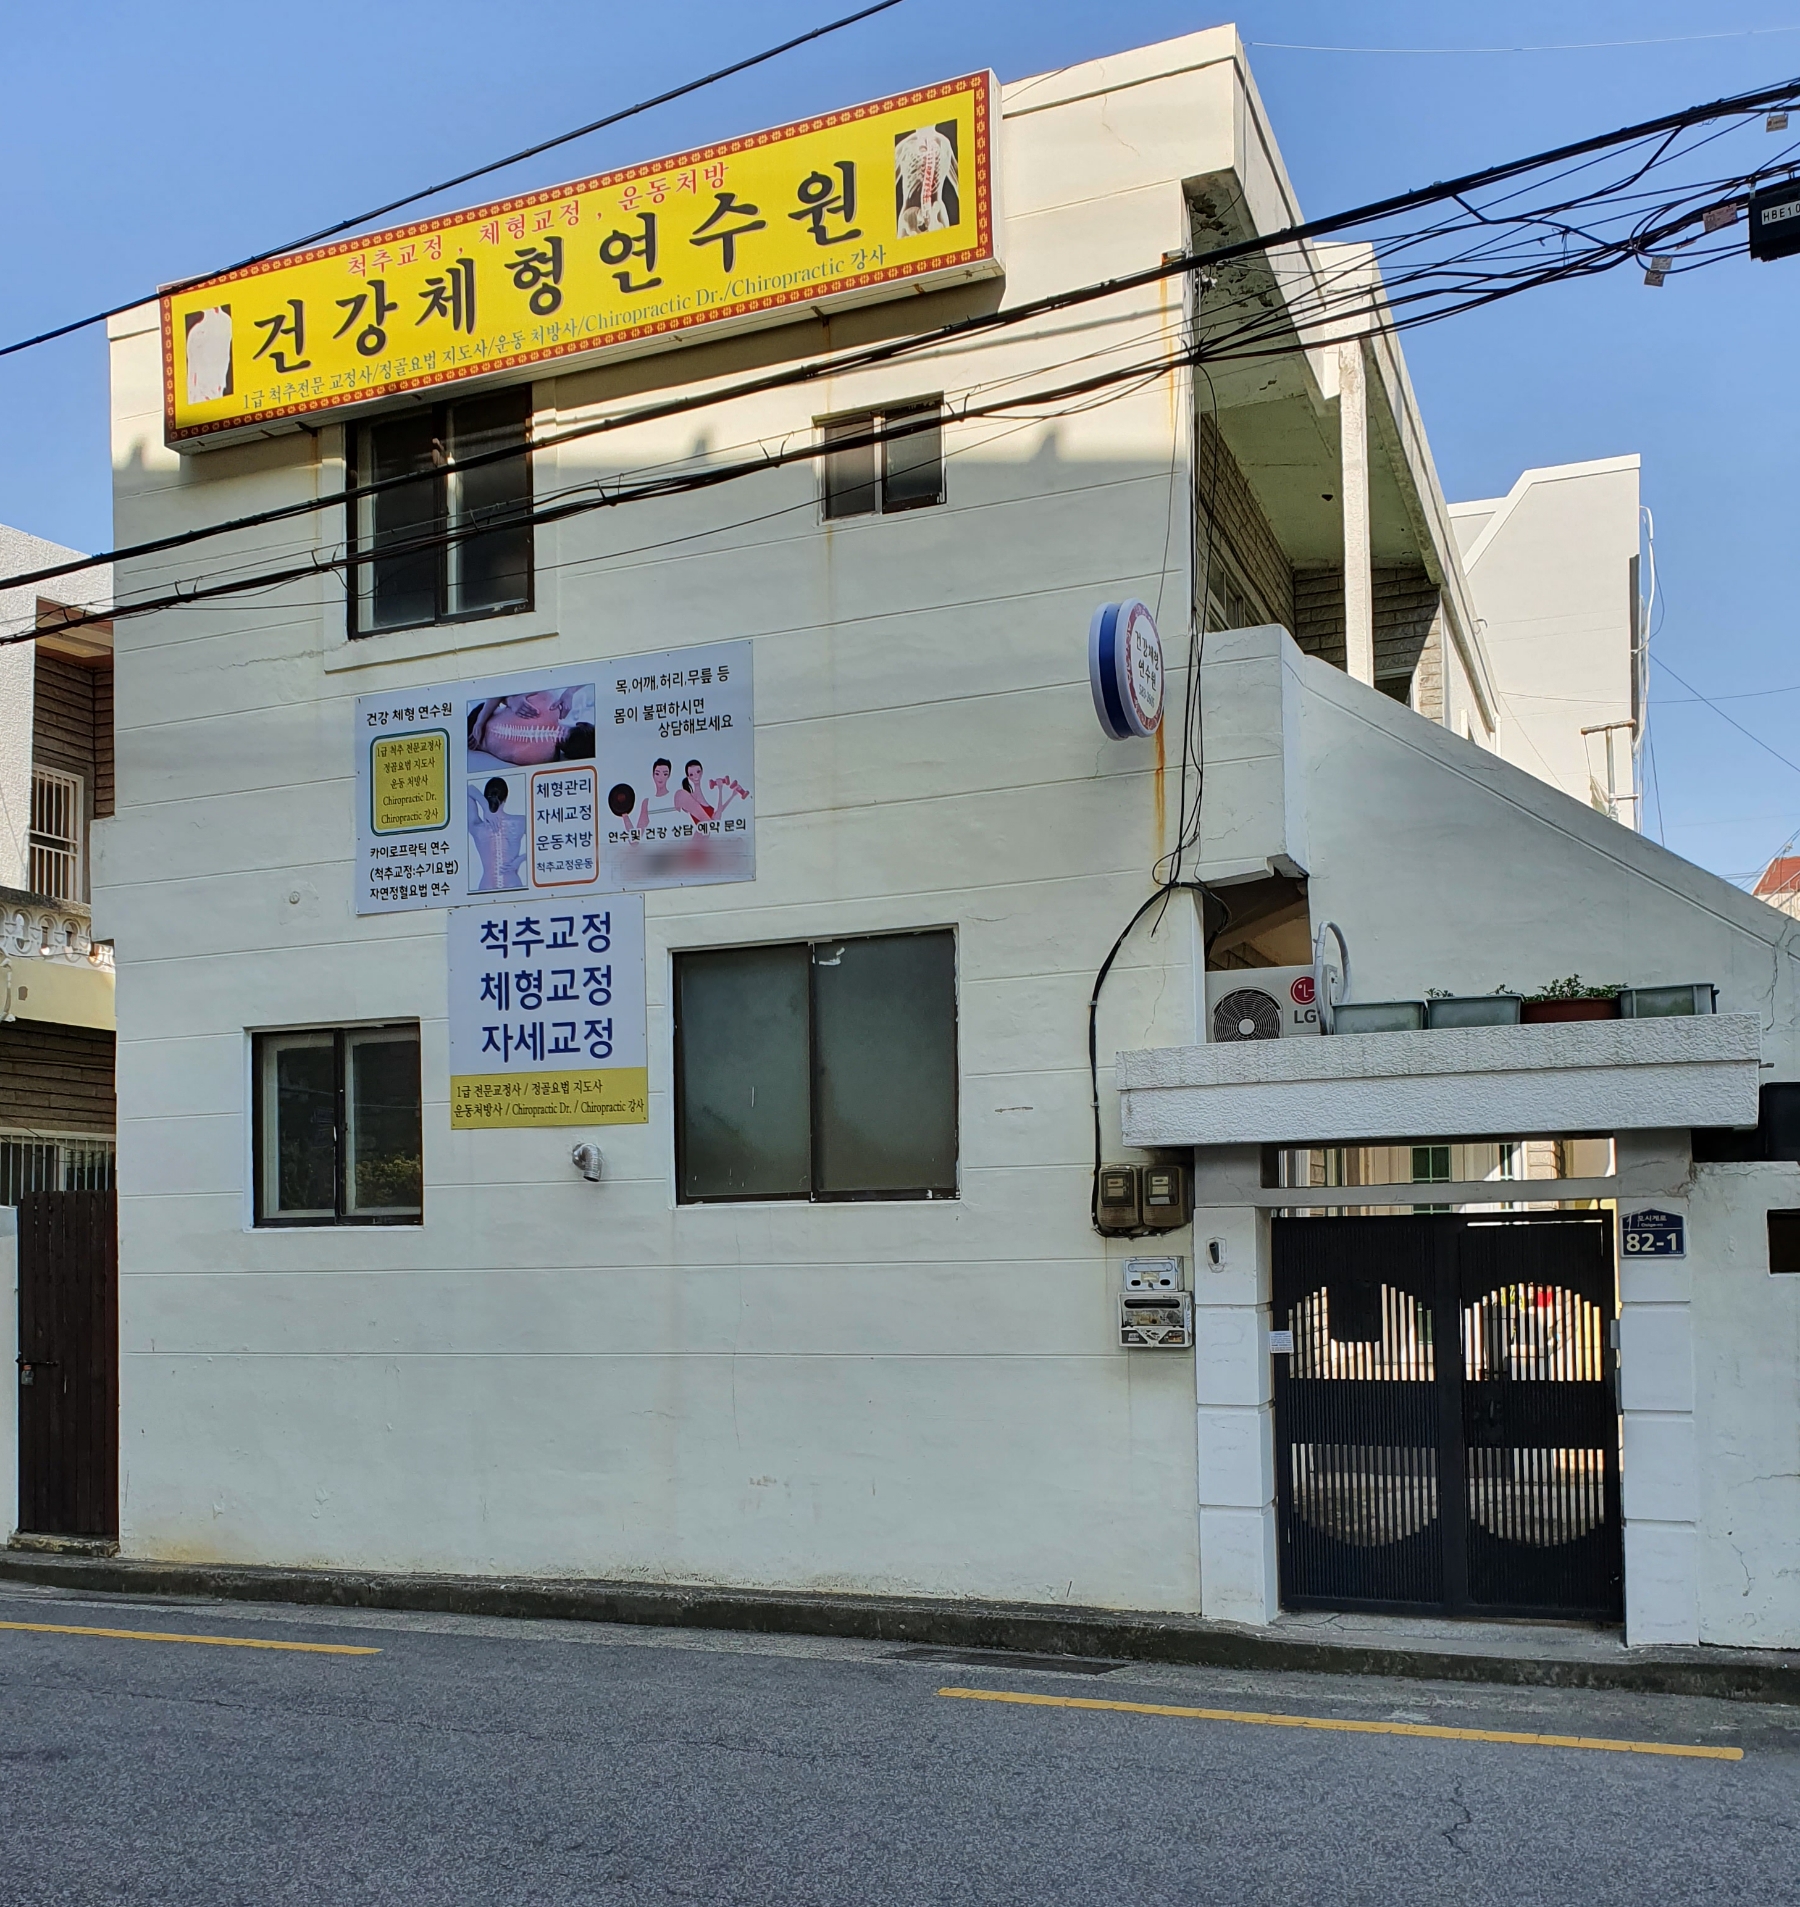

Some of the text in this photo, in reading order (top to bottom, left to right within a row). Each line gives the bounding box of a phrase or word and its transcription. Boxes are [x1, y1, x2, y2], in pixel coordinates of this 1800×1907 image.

[617, 162, 730, 212] 운동처방
[243, 389, 265, 410] 1급
[268, 376, 325, 402] 척추전문
[530, 294, 691, 346] 처방사/Chiropractic
[695, 257, 845, 307] Dr./Chiropractic
[851, 244, 886, 271] 강사
[615, 665, 730, 695] 목,어깨,허리,무릎 등
[366, 702, 453, 727] 건강 체형 연수원
[613, 697, 705, 725] 몸이 불편하시면
[658, 714, 734, 739] 상담해보세요
[377, 739, 442, 758] 1급 척추 전문교정사
[383, 756, 436, 774] 정골요법 지도사
[390, 774, 429, 790] 운동 처방사
[536, 777, 592, 799] 체형관리
[382, 791, 437, 807] Chiropractic Dr.
[381, 807, 439, 825] Chiropractic 강사
[536, 804, 593, 824] 자세교정
[645, 828, 668, 840] 건강
[671, 824, 694, 838] 상담
[697, 821, 721, 835] 예약
[724, 818, 747, 832] 문의
[370, 840, 450, 860] 카이로프락틱 연수
[536, 831, 594, 851] 운동처방
[369, 859, 459, 882] (척추교정:수기요법)
[536, 857, 594, 873] 척추교정운동
[369, 882, 451, 901] 자연정혈요법 연수
[480, 911, 612, 959] 척추교정
[479, 964, 613, 1012] 체형교정
[1294, 1009, 1317, 1024] LG
[481, 1018, 614, 1064] 자세교정
[456, 1085, 472, 1099] 1급
[473, 1082, 522, 1099] 전문교정사
[531, 1080, 571, 1097] 정골요법
[573, 1079, 603, 1095] 지도사
[453, 1102, 503, 1118] 운동처방사
[512, 1102, 557, 1118] Chiropractic
[559, 1102, 572, 1115] Dr.
[580, 1099, 627, 1116] Chiropractic
[627, 1098, 645, 1113] 강사
[1626, 1232, 1677, 1252] 82-1
